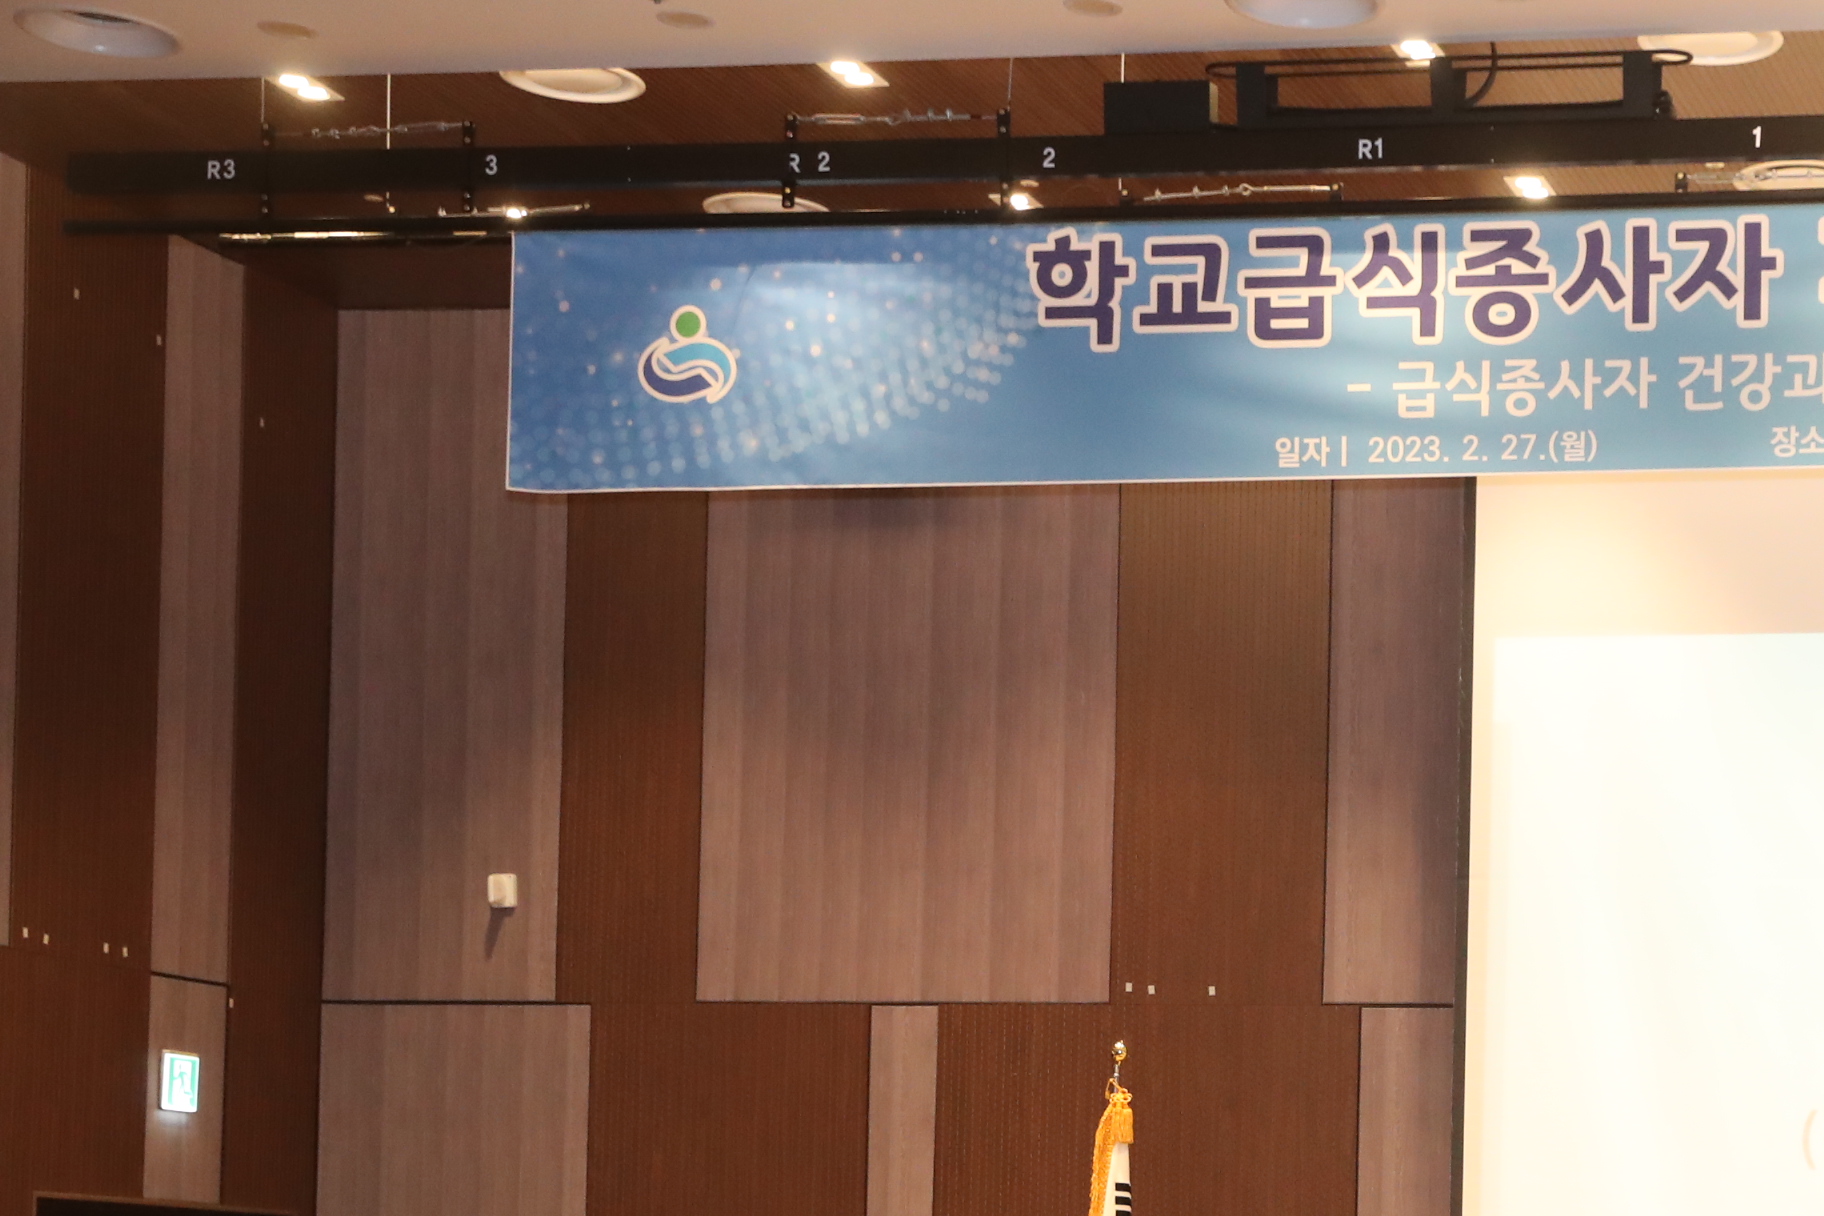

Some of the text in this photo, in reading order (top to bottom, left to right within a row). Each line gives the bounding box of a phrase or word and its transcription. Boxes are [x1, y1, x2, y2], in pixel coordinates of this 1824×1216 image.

[1357, 137, 1384, 160] R1
[1752, 126, 1762, 148] 1
[485, 154, 498, 175] 3
[1042, 146, 1056, 169] 2
[207, 159, 236, 180] R3
[1028, 215, 1782, 351] 학교급식종사자
[1392, 357, 1658, 419] 급식종사자
[1367, 435, 1450, 465] 2023.
[1462, 434, 1489, 462] 2.
[1501, 430, 1599, 464] 27.(월)
